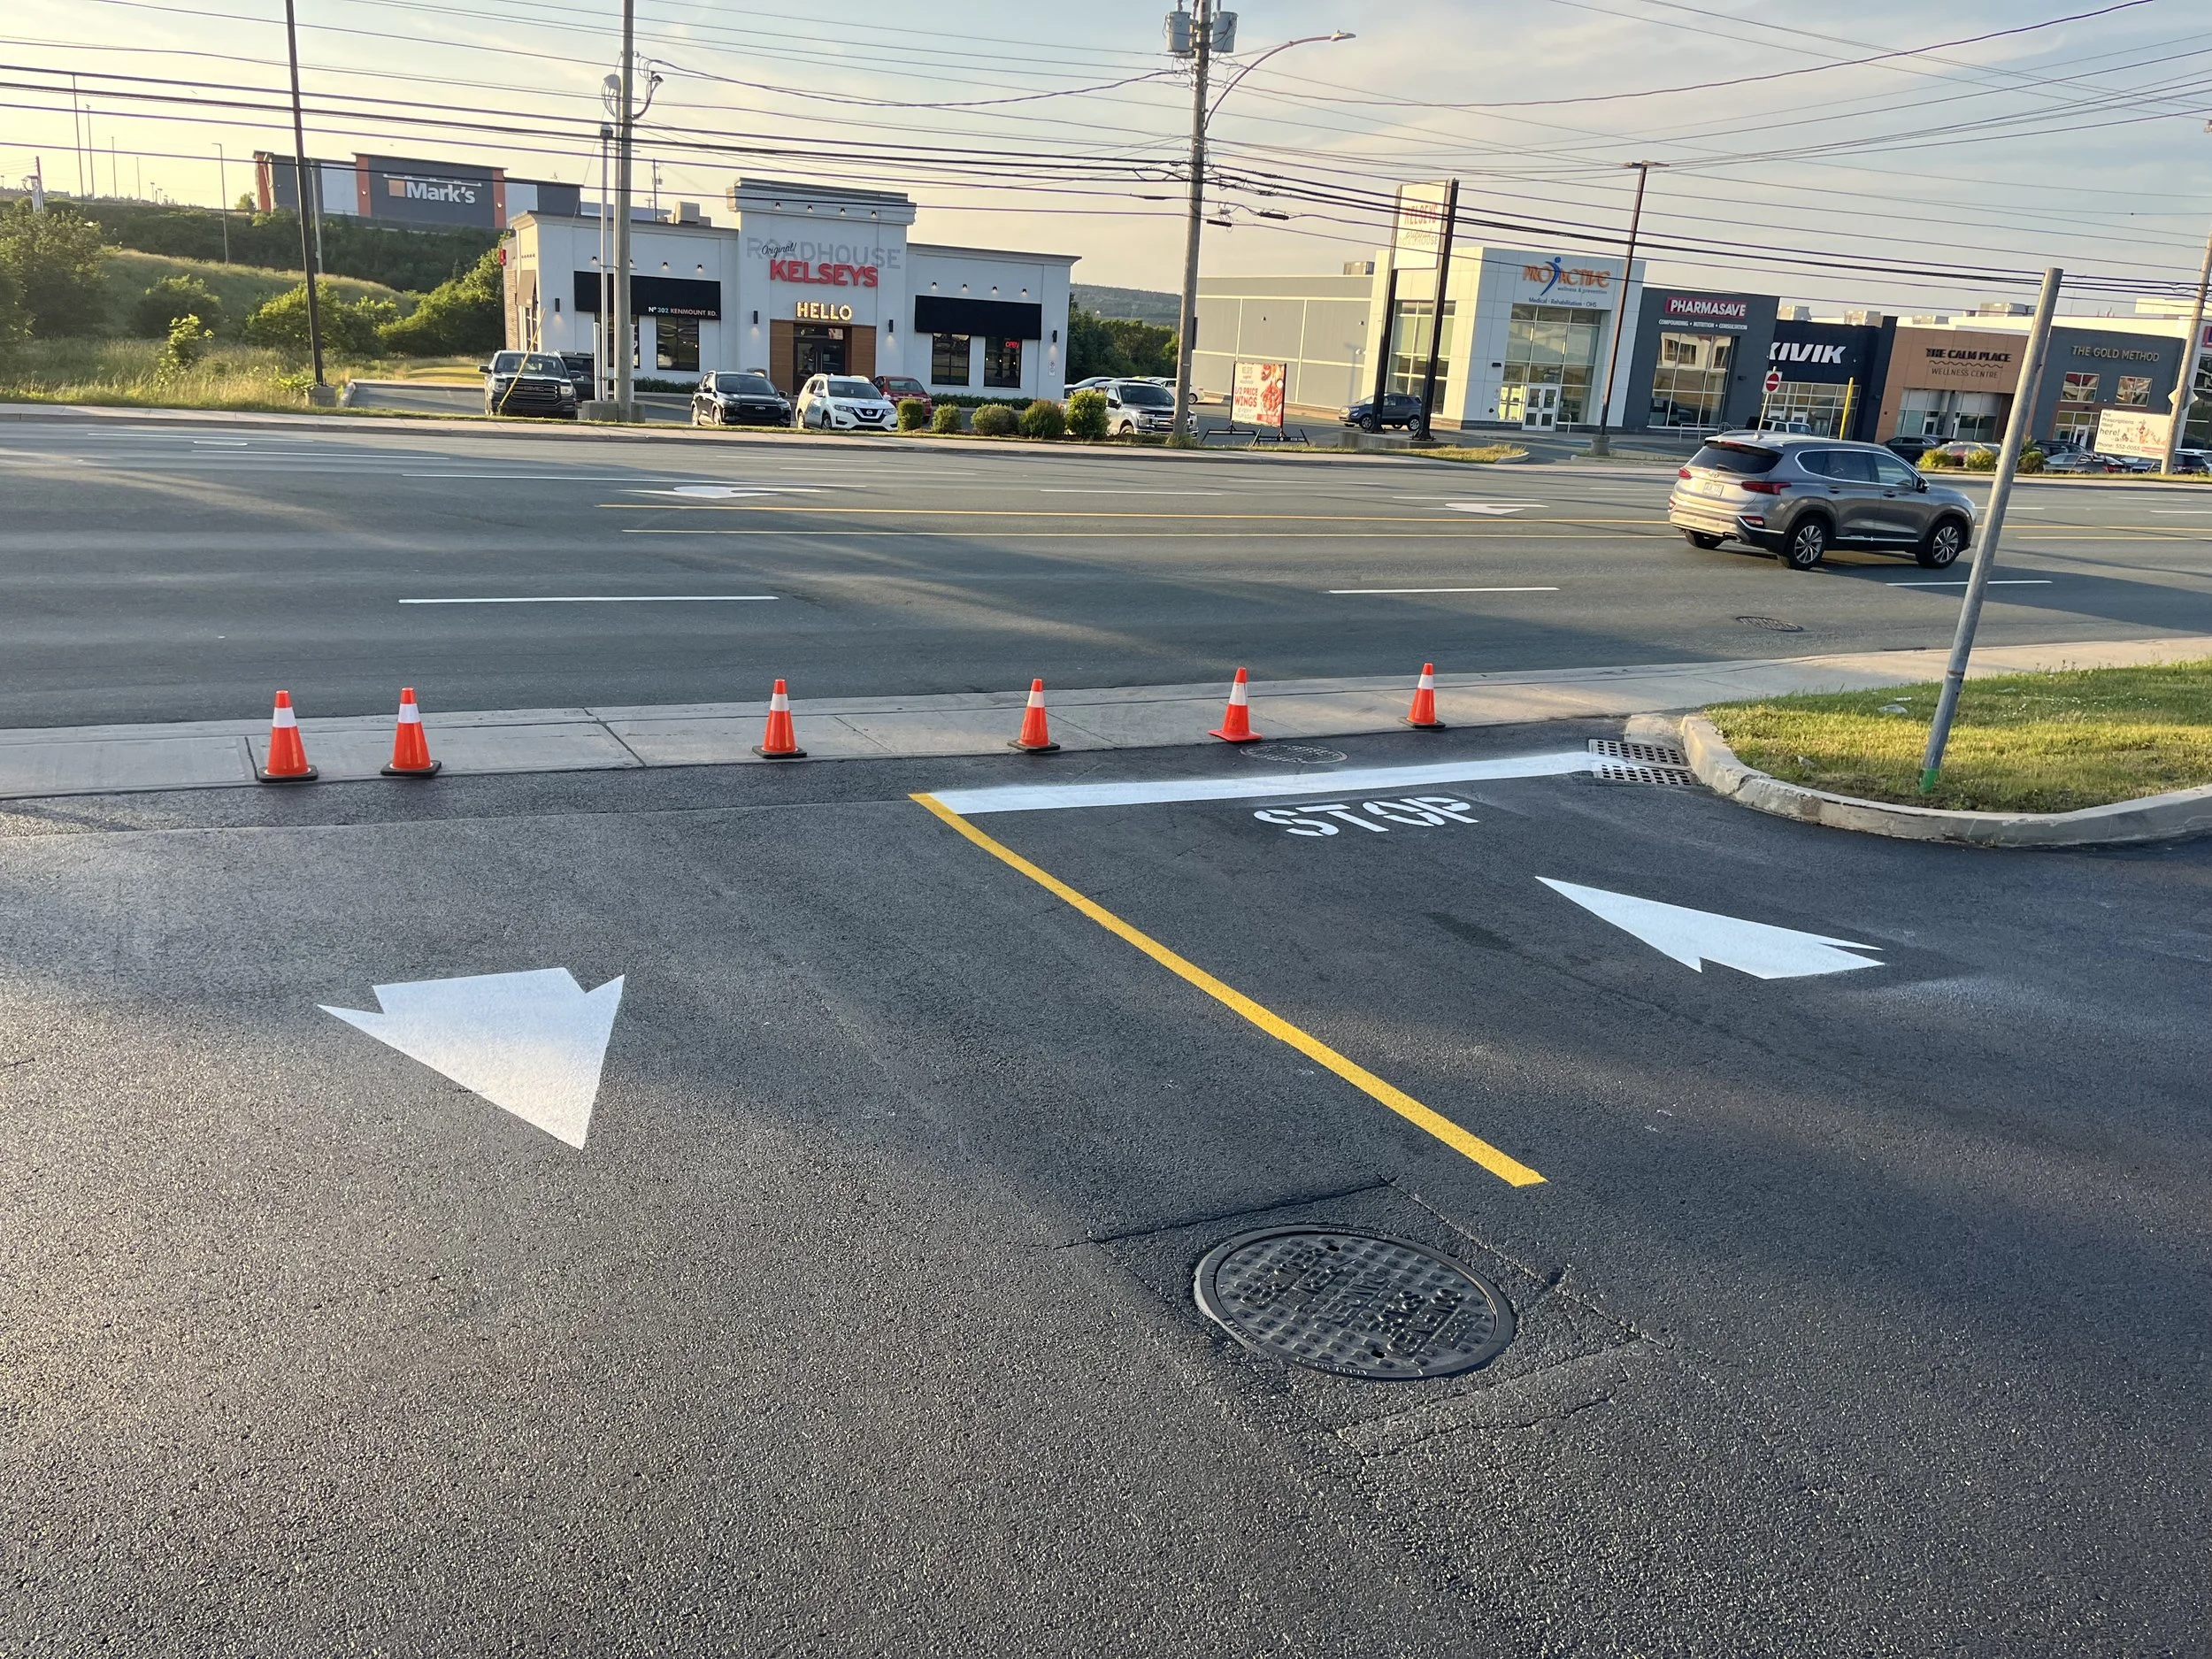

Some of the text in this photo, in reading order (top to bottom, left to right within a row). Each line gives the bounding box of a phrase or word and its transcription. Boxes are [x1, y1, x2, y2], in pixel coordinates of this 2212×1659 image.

[407, 181, 476, 204] Mark's
[747, 236, 901, 270] ROADHOUSE
[770, 258, 879, 288] KELSEYS
[796, 302, 853, 321] HELLO
[1671, 299, 1747, 317] PHARMASAVE
[1769, 342, 1847, 364] KIVIK
[1925, 348, 2012, 363] THE CALM PLACE
[2072, 345, 2160, 362] THE GOLD METHOD
[1932, 367, 1998, 379] WELLNESS CENTRE
[1243, 388, 1258, 396] PRICE
[1235, 396, 1257, 407] WINGS
[1254, 796, 1479, 837] STOP
